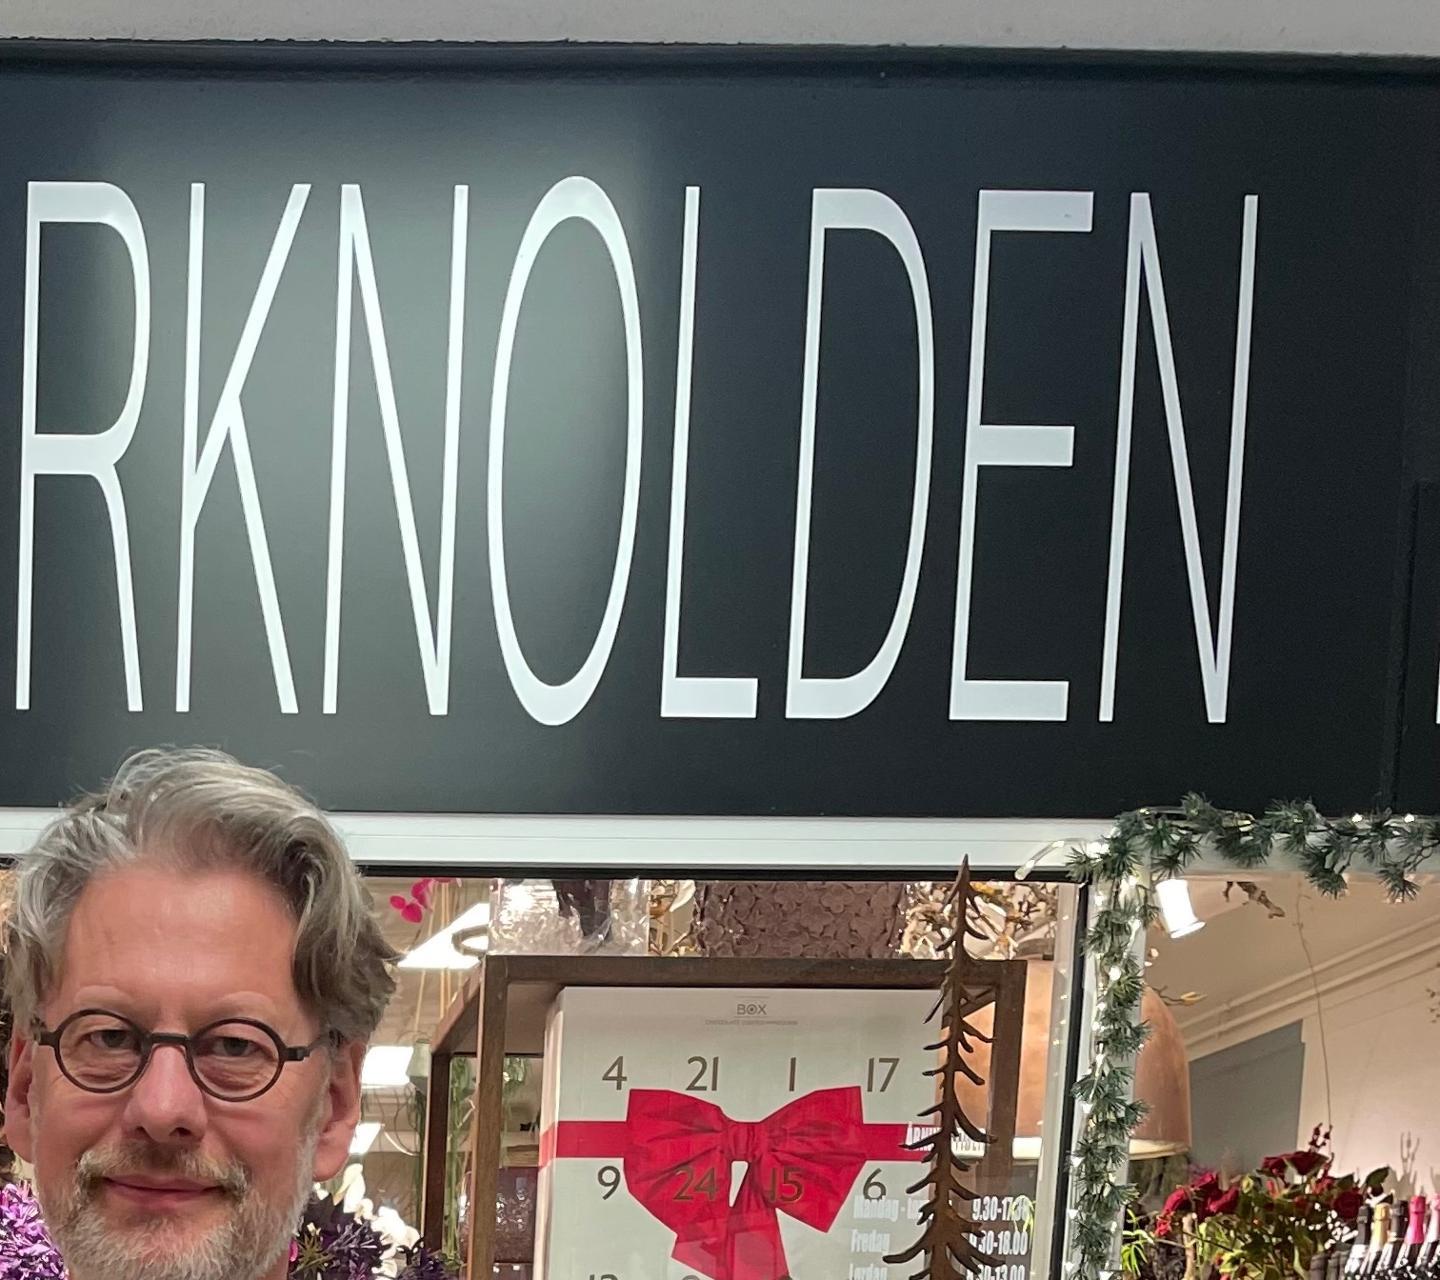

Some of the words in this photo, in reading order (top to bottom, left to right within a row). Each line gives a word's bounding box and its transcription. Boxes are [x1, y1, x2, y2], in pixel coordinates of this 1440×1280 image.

[736, 1004, 767, 1015] BOX
[602, 1056, 628, 1091] 4
[686, 1056, 719, 1091] 21
[789, 1057, 796, 1092] 1
[866, 1057, 900, 1093] 17
[597, 1165, 621, 1201] 9
[672, 1165, 718, 1201] 24
[769, 1166, 803, 1203] 15
[862, 1168, 887, 1202] 6
[850, 1229, 890, 1256] Fredag
